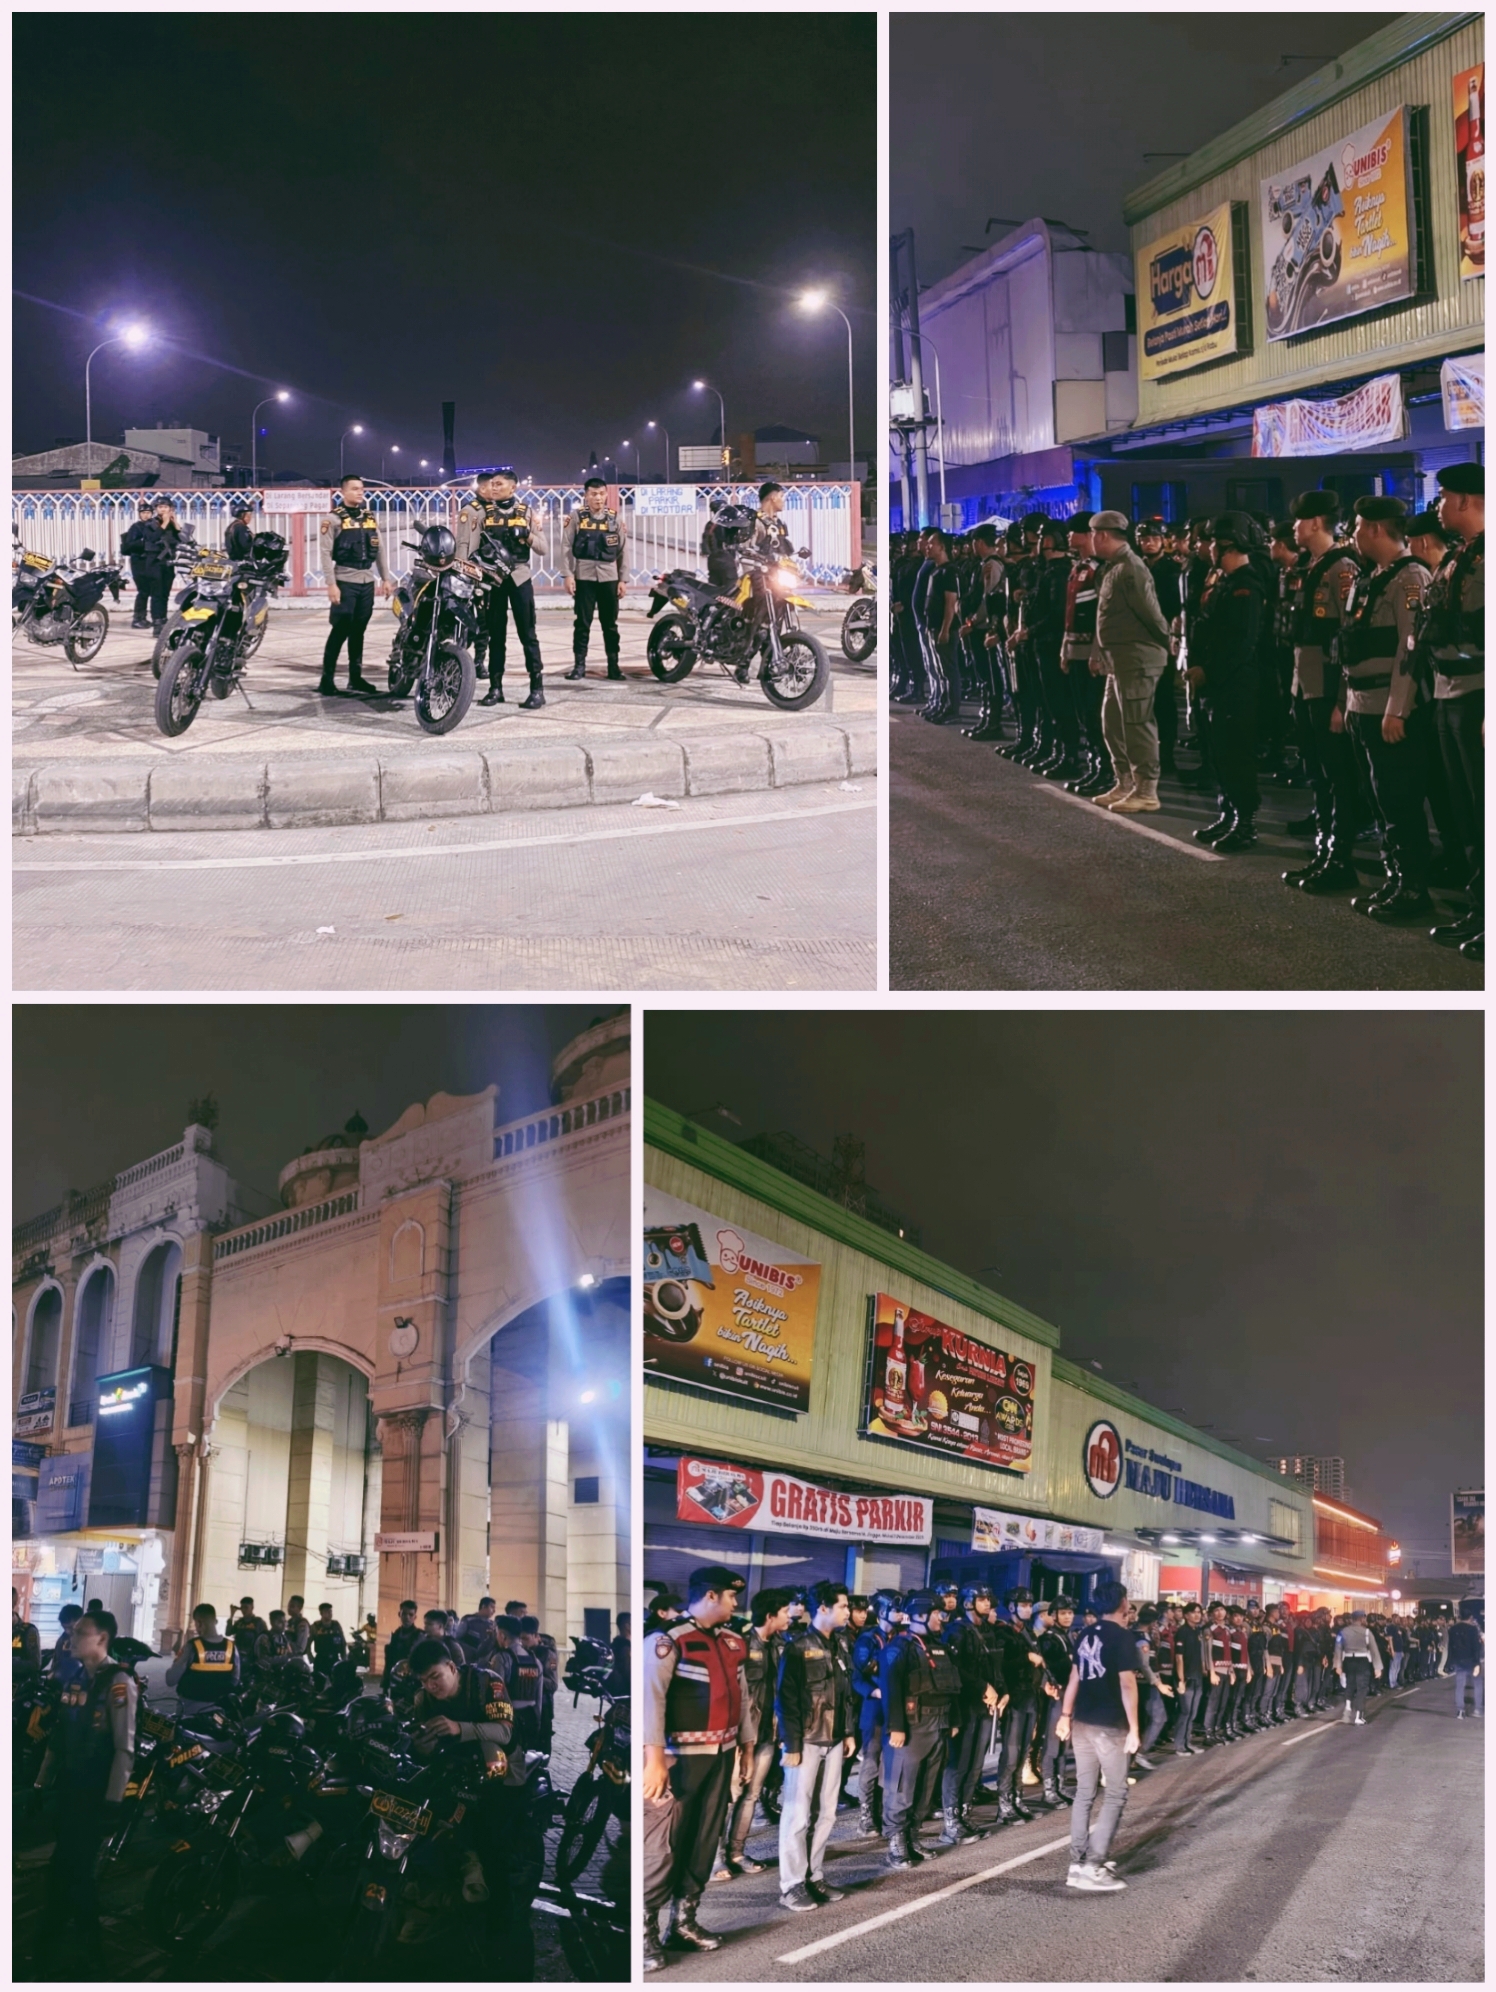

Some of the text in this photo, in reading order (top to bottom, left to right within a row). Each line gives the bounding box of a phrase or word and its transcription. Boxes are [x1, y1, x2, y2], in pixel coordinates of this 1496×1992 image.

[1354, 145, 1387, 176] UNIBIS
[1150, 259, 1193, 299] Harga
[648, 496, 680, 505] PARKIR
[651, 487, 684, 496] LARANG
[650, 504, 694, 514] TROTOAR
[739, 1254, 796, 1290] UNIBIS
[733, 1289, 788, 1322] Asiknya
[717, 1326, 742, 1343] bikin
[733, 1306, 780, 1337] Tartlet
[941, 1328, 1007, 1378] KURNIA
[49, 1475, 76, 1486] APOTEK
[1124, 1458, 1173, 1501] MAJU
[770, 1478, 924, 1533] GRATIS PARKIR
[169, 1743, 203, 1769] POLISI
